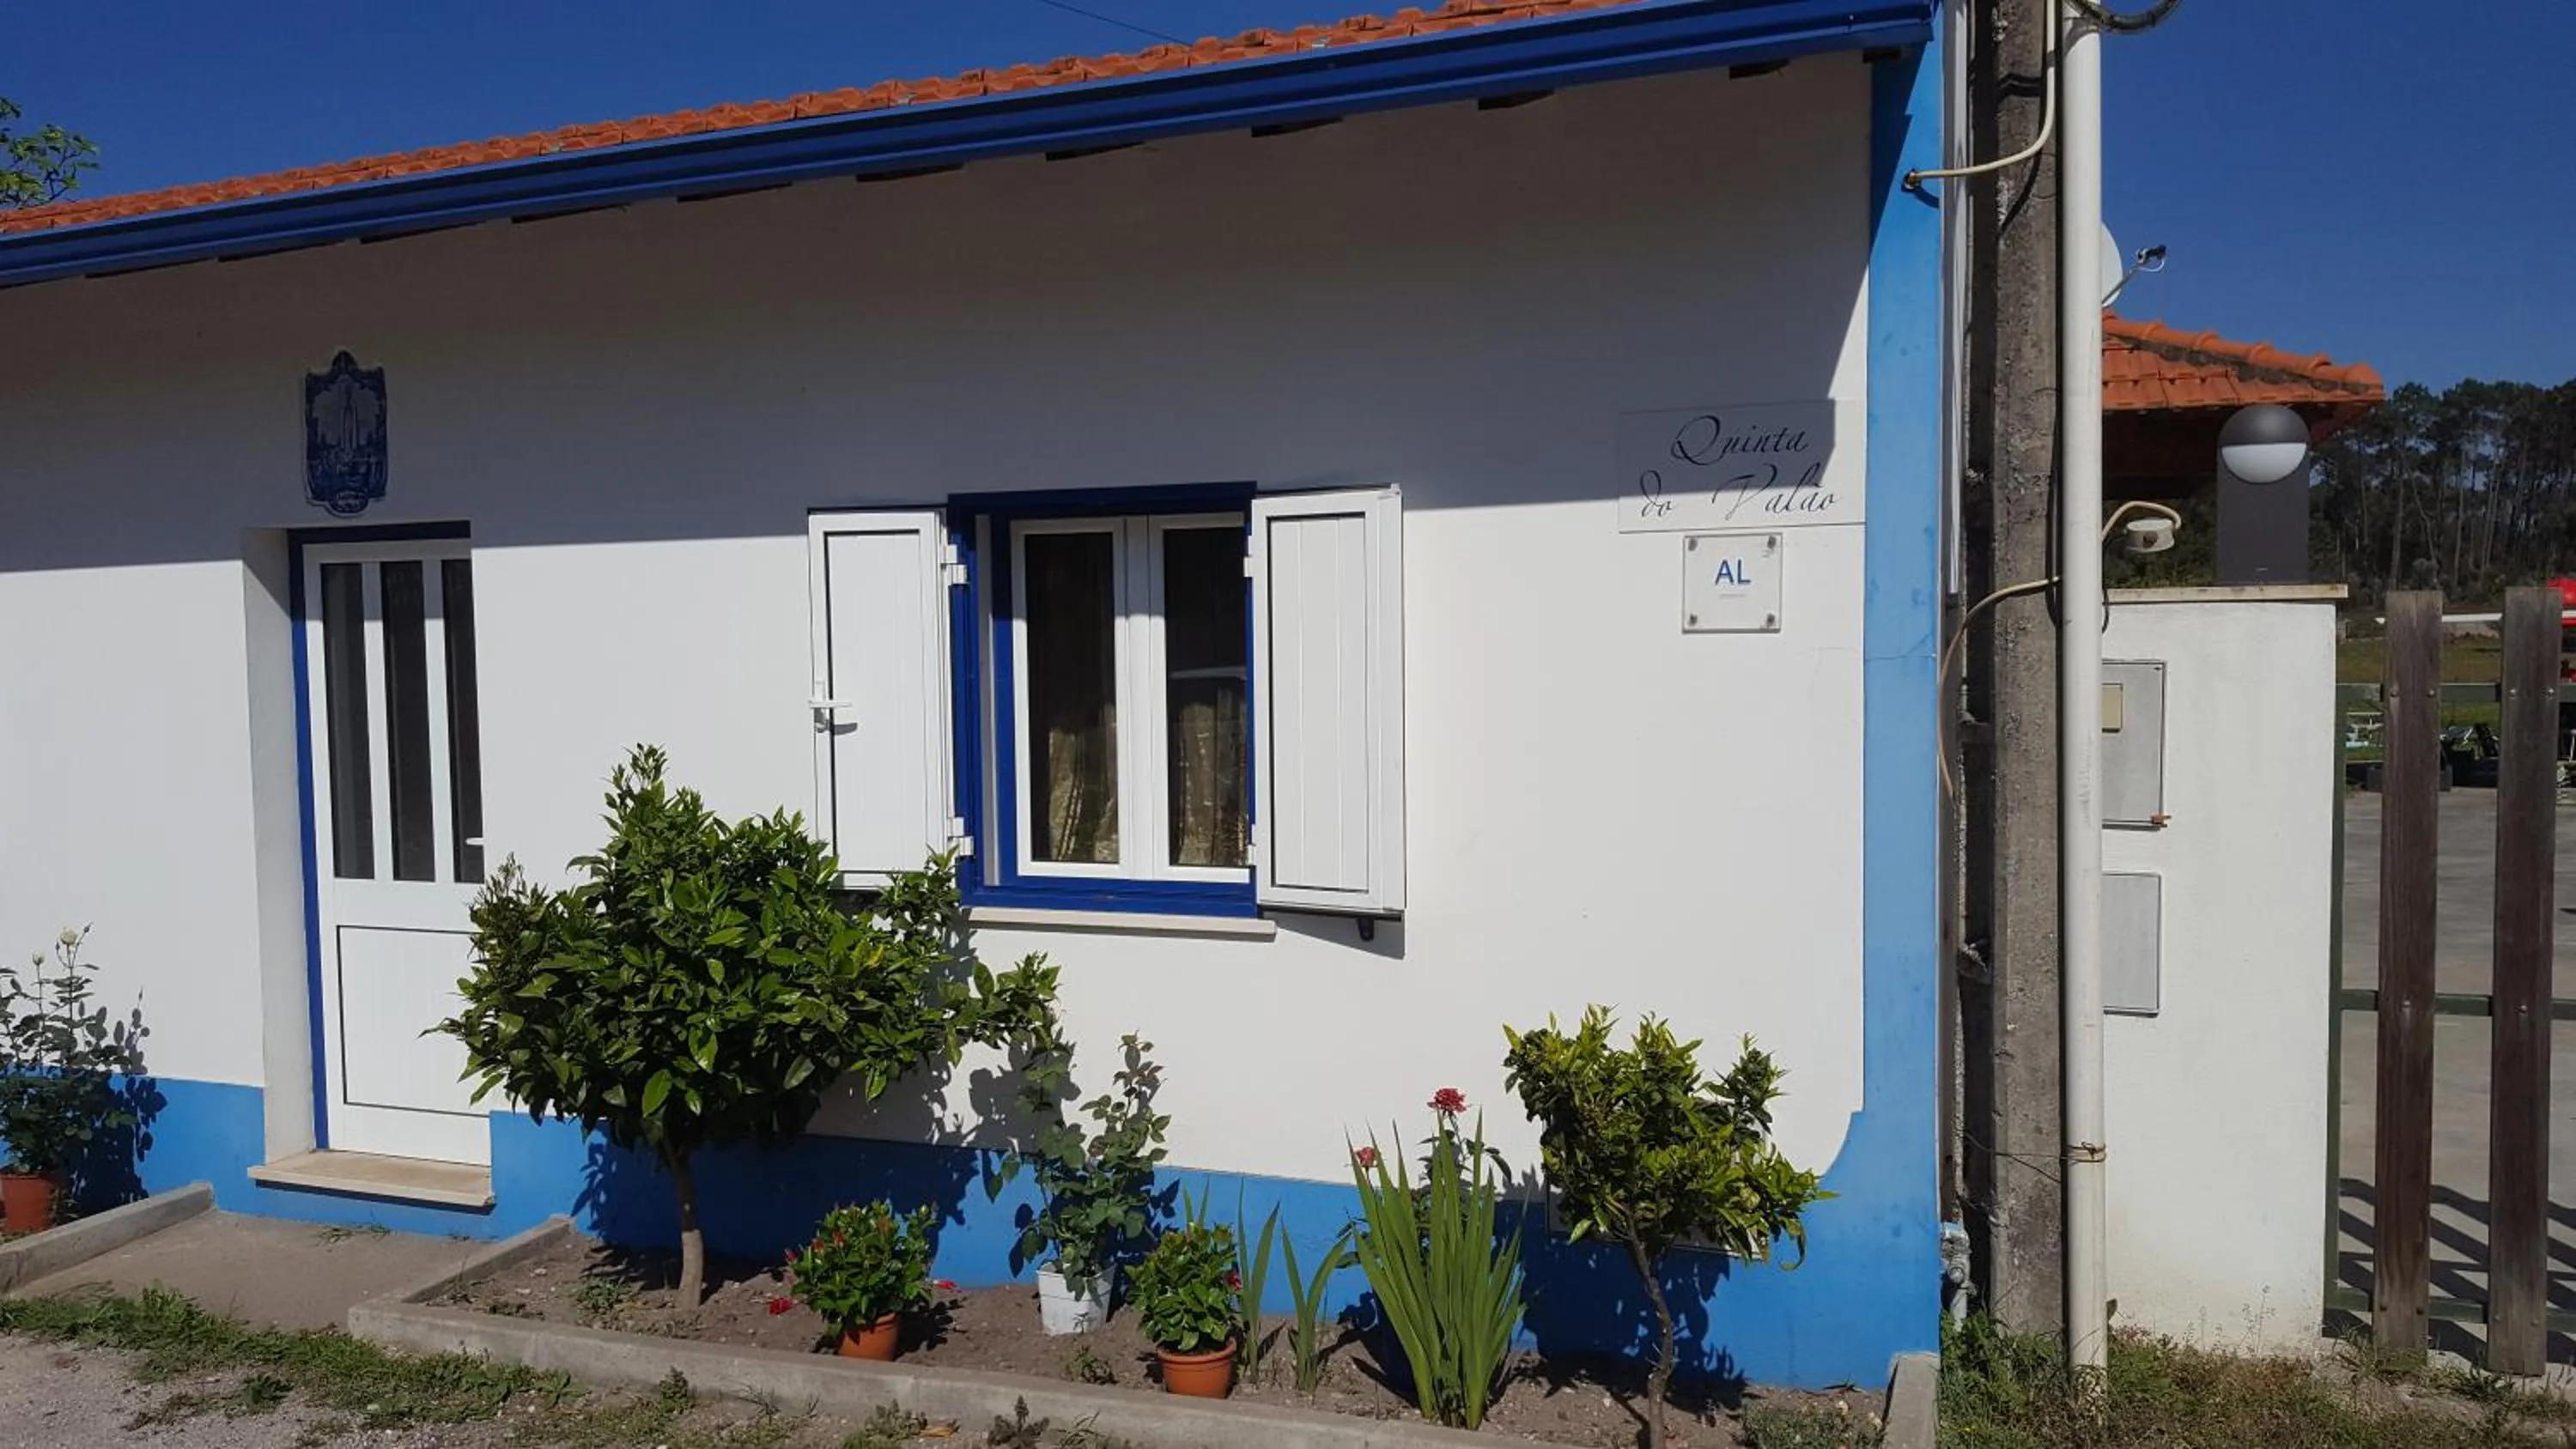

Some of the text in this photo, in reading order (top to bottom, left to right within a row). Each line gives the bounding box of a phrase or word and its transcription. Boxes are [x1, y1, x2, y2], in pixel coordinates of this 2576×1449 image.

[1671, 415, 1808, 465] Quinta
[1640, 470, 1672, 517] do
[1715, 559, 1752, 585] AL
